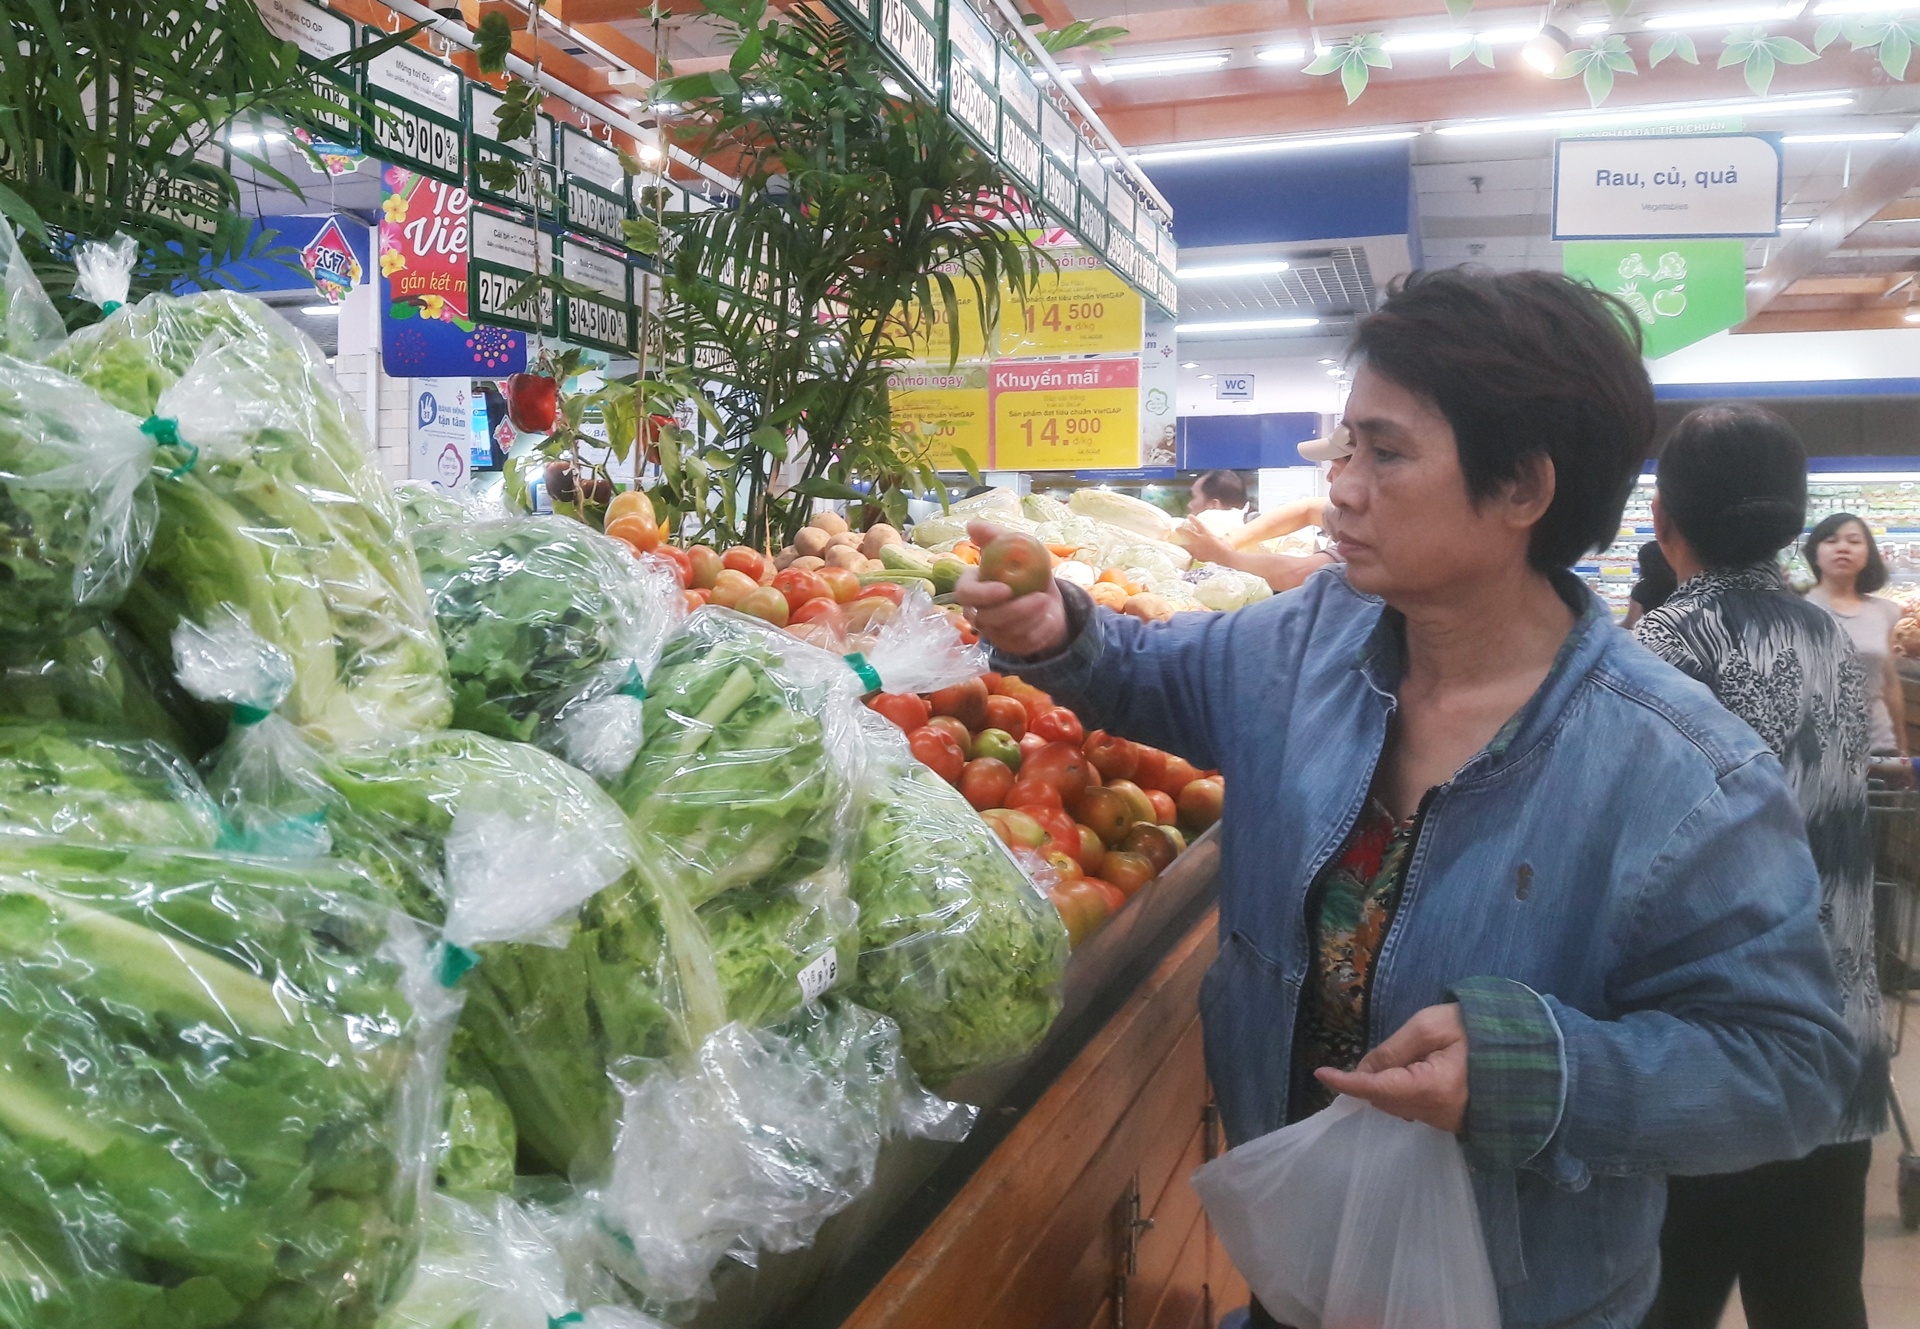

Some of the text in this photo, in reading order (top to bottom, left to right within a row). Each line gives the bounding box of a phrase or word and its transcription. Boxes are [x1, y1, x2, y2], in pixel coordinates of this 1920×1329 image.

[1596, 165, 1738, 189] Rau, củ, quả
[1641, 202, 1689, 212] Vegetables
[403, 215, 467, 264] Việ
[315, 247, 344, 274] 2017
[401, 271, 425, 294] gắn
[429, 274, 450, 291] kết
[569, 302, 617, 337] 34.500
[996, 368, 1099, 390] Khuyến mãi
[1225, 379, 1247, 390] WC
